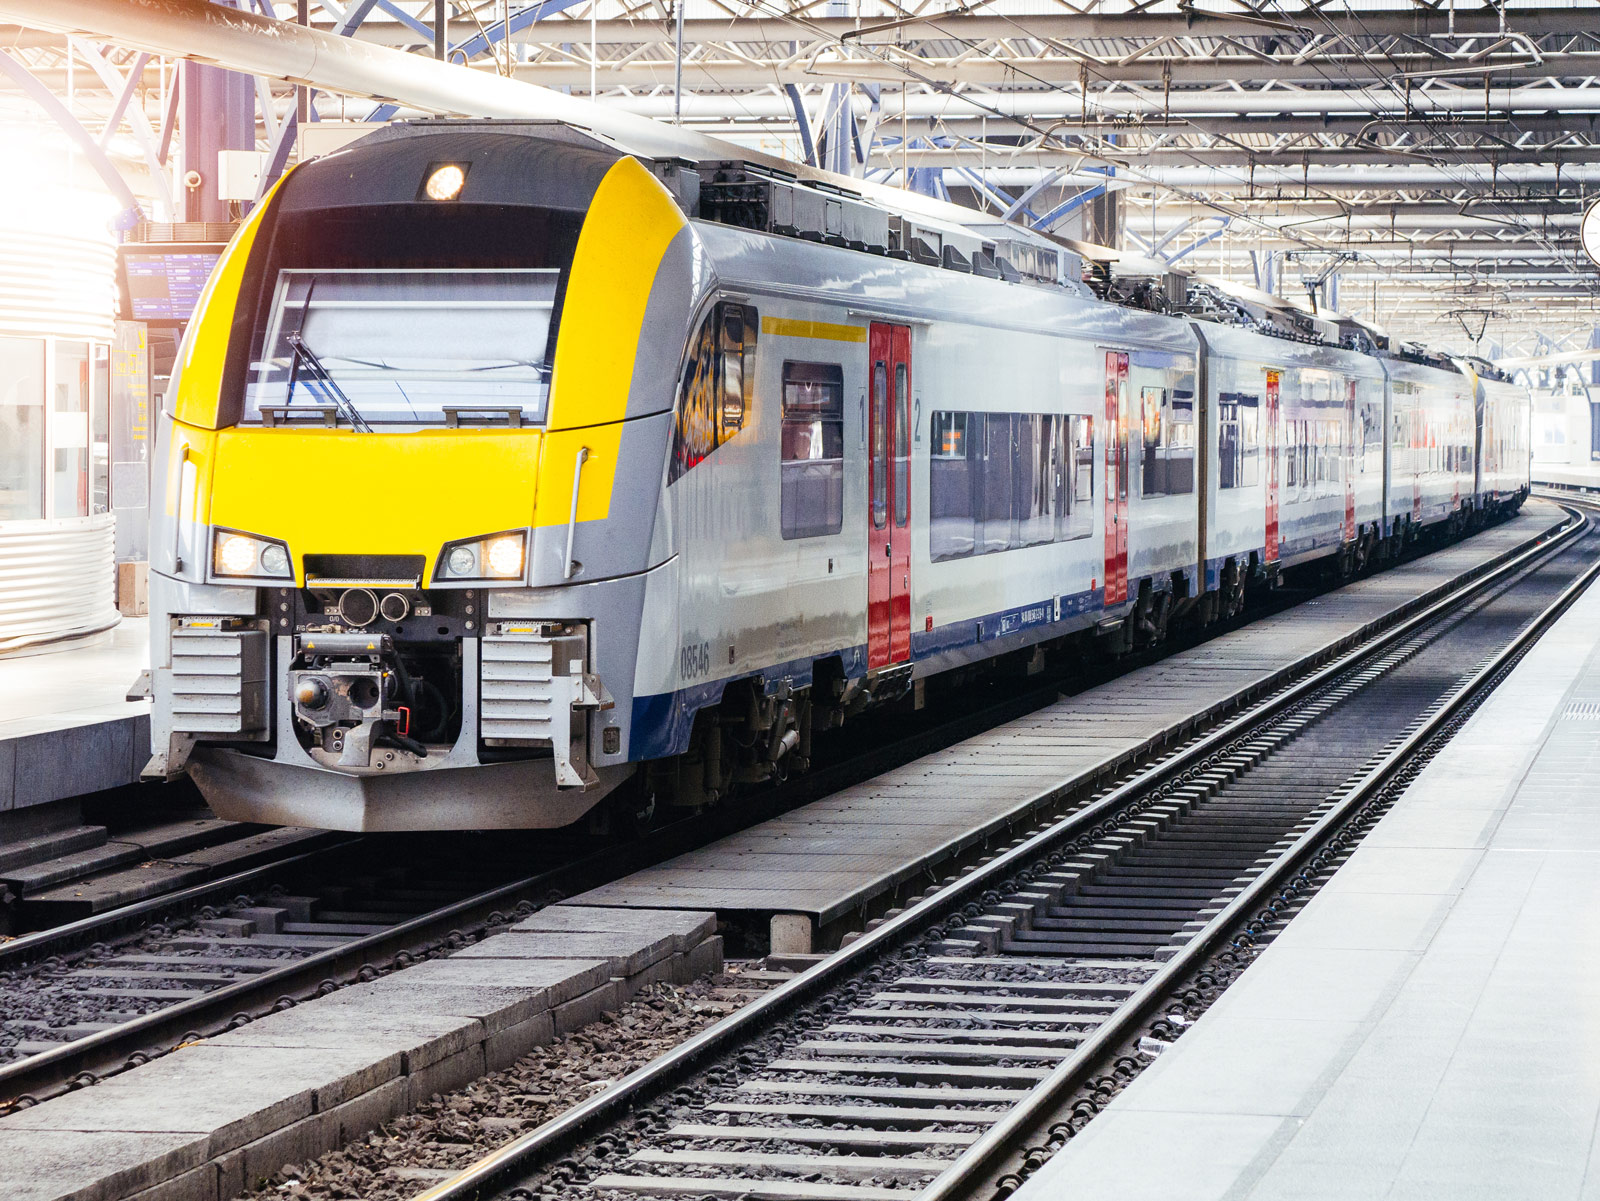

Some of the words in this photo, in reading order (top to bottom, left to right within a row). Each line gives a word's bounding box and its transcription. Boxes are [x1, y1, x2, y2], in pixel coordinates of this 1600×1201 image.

[860, 394, 865, 442] 1
[914, 397, 921, 442] 2
[681, 641, 710, 681] 08546
